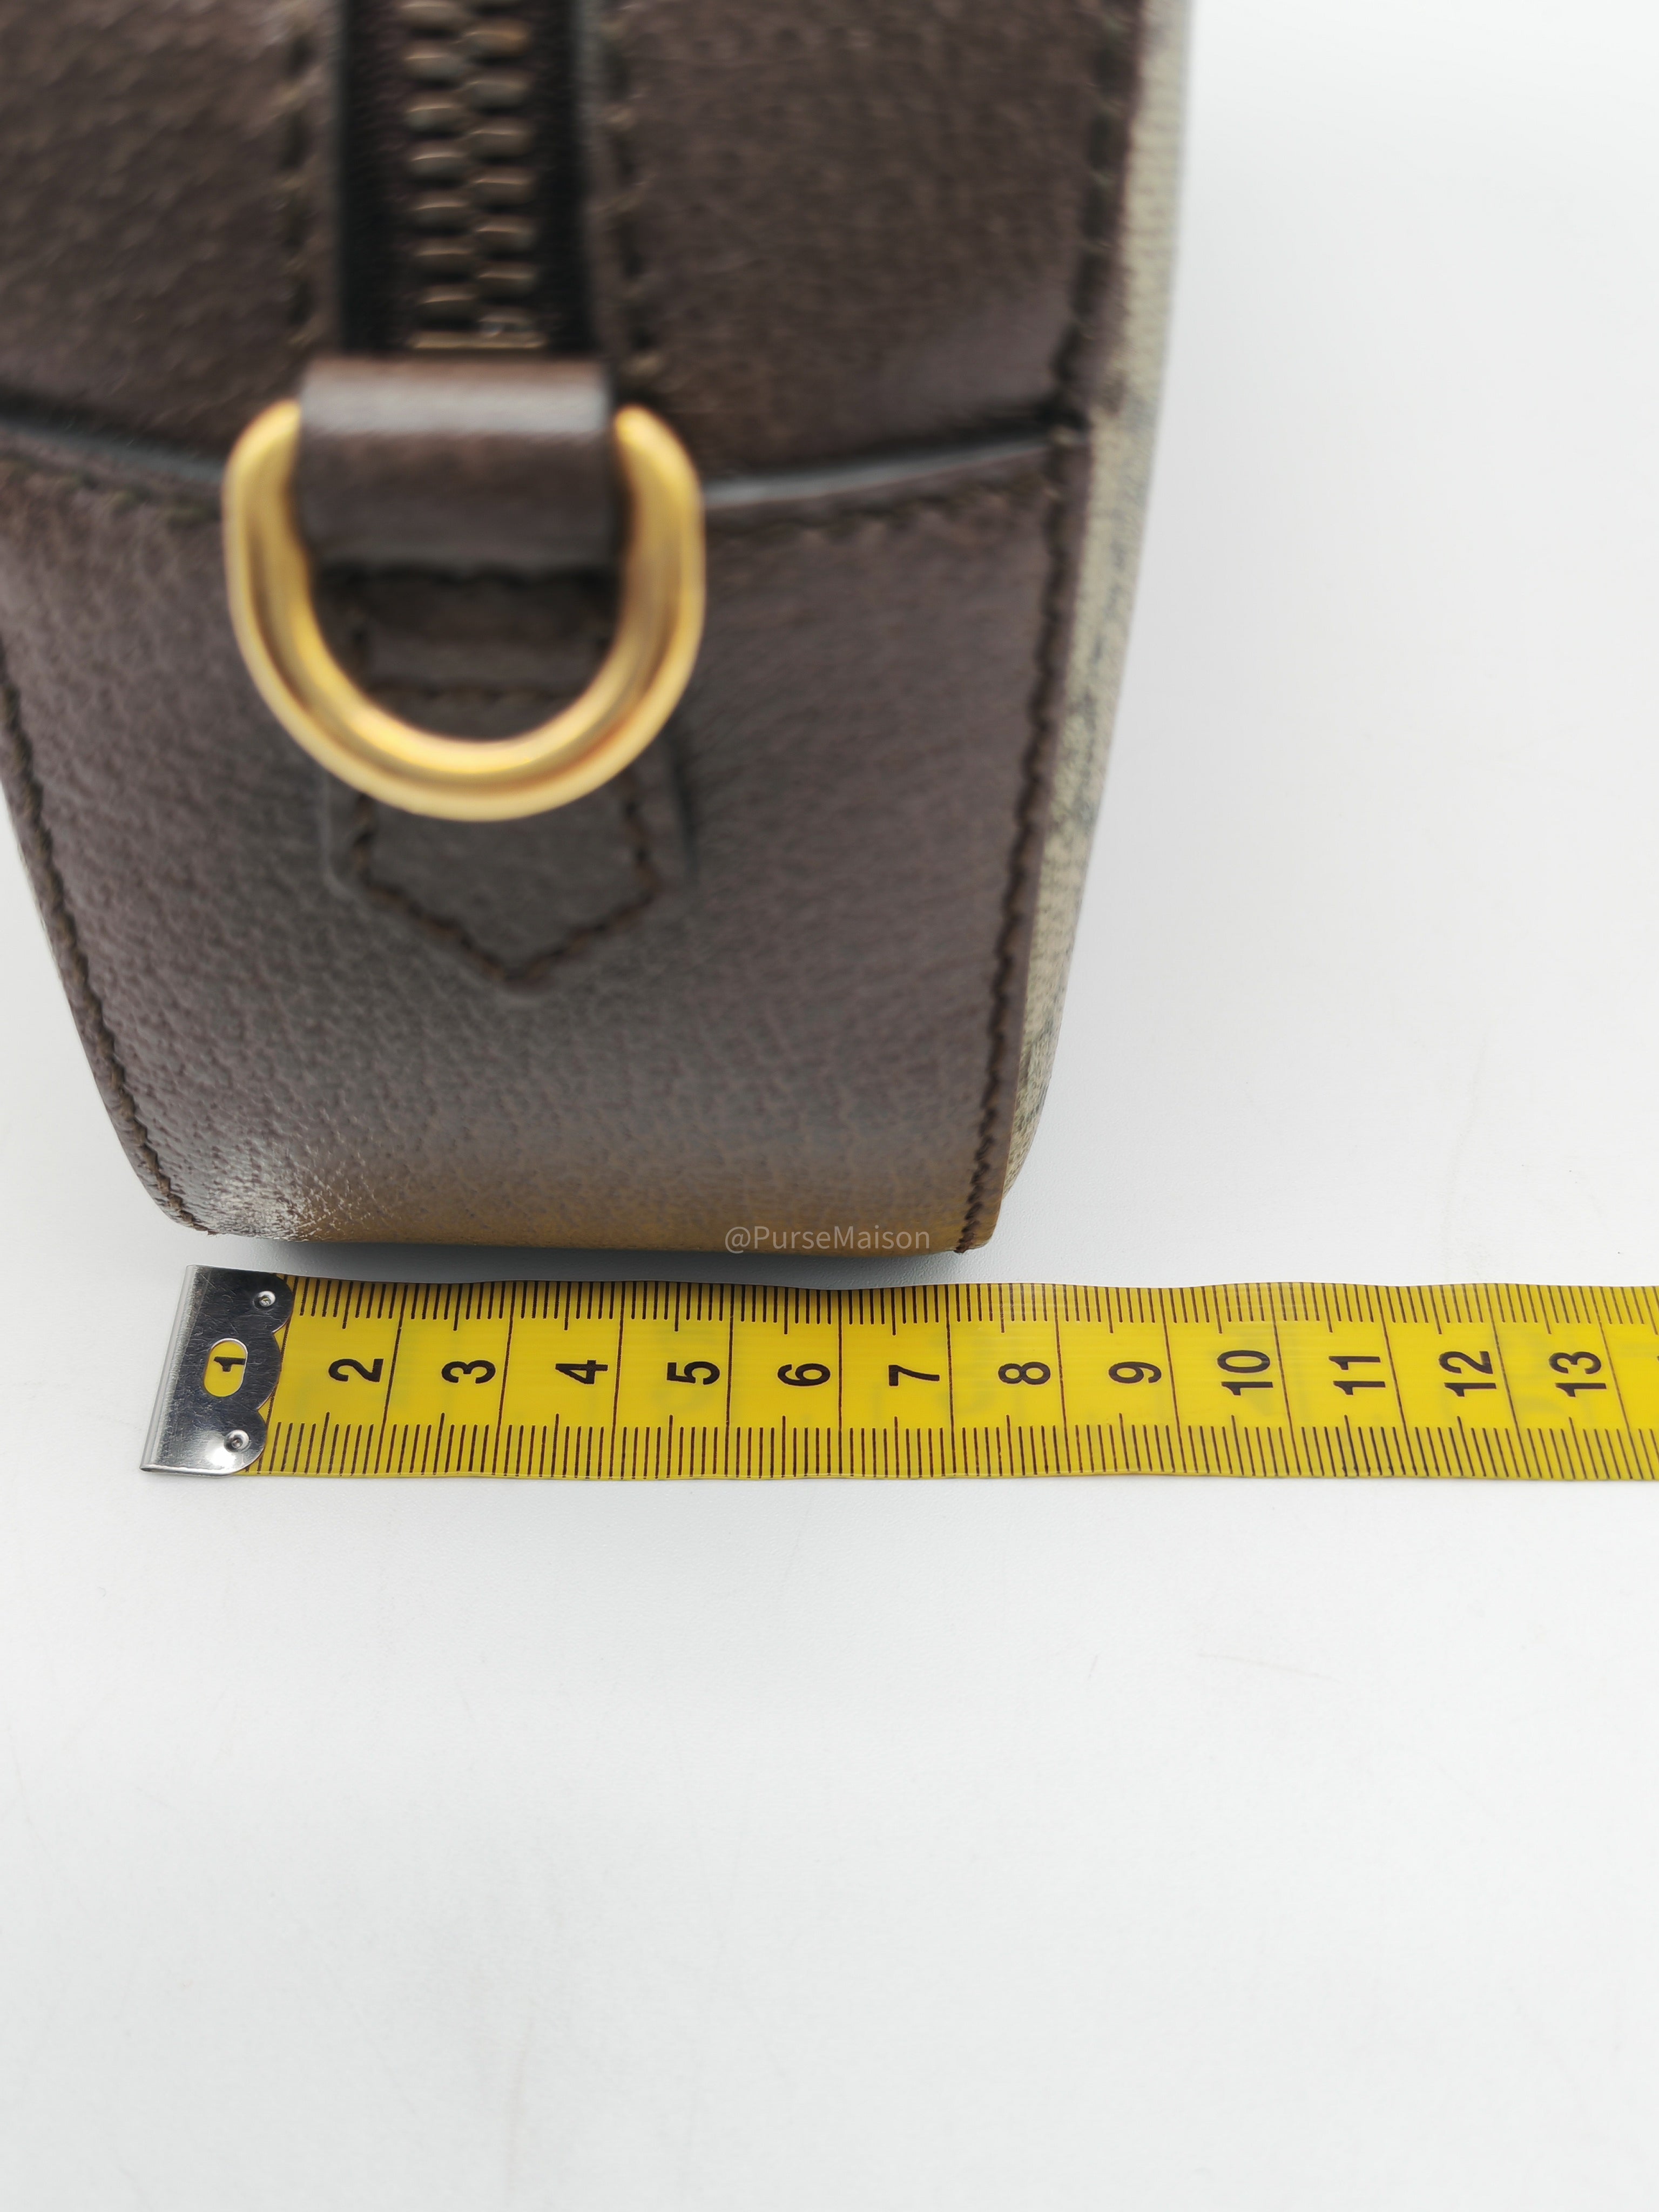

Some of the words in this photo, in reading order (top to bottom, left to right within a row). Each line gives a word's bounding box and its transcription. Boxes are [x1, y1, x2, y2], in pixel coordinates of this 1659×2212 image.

[212, 1355, 247, 1373] 1
[326, 1357, 385, 1384] 2
[440, 1358, 497, 1385] 3
[554, 1359, 610, 1386] 4
[665, 1360, 721, 1386] 5
[776, 1362, 832, 1388] 6
[887, 1364, 941, 1387] 7
[997, 1361, 1052, 1386] 8
[1107, 1360, 1163, 1385] 9
[1216, 1349, 1274, 1396] 10
[1329, 1355, 1386, 1396] 11
[1439, 1350, 1497, 1398] 12
[1549, 1351, 1607, 1398] 13
